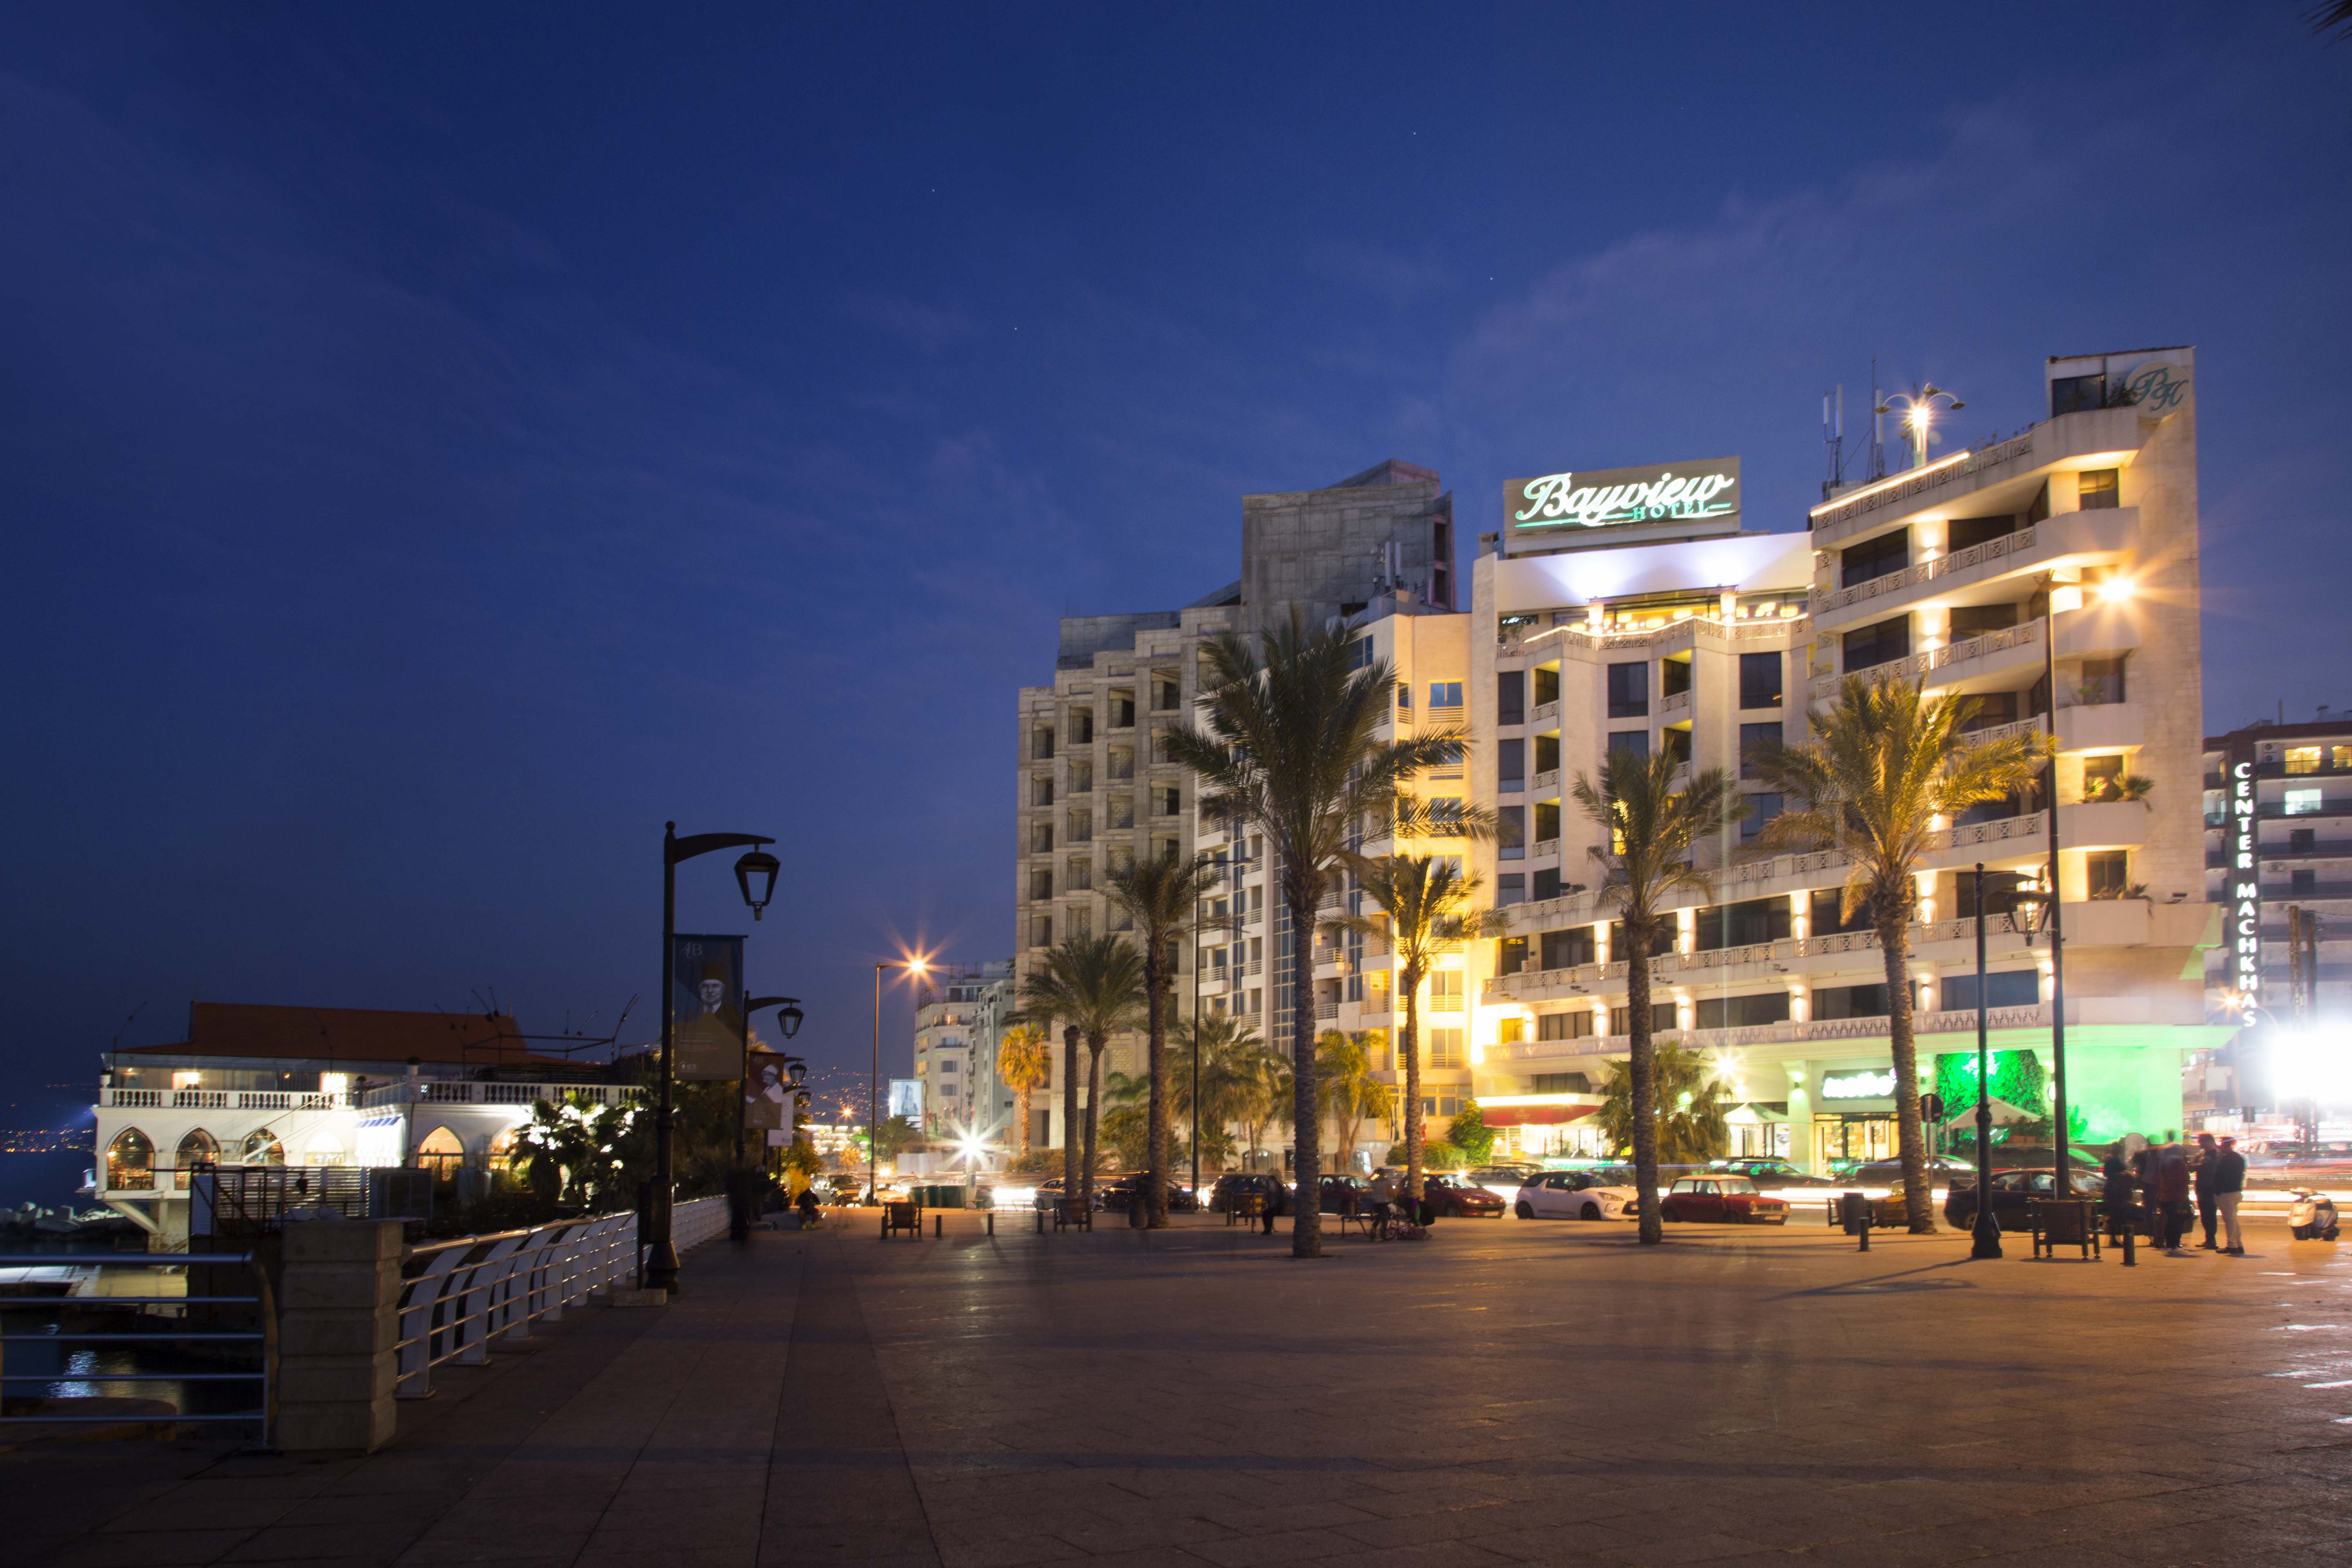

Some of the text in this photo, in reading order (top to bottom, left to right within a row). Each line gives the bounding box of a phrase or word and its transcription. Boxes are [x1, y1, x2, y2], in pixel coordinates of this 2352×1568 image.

[1515, 472, 1734, 526] Bayview
[1633, 501, 1710, 520] HOTEL
[2235, 762, 2257, 1027] CENTER MACHKHAS
